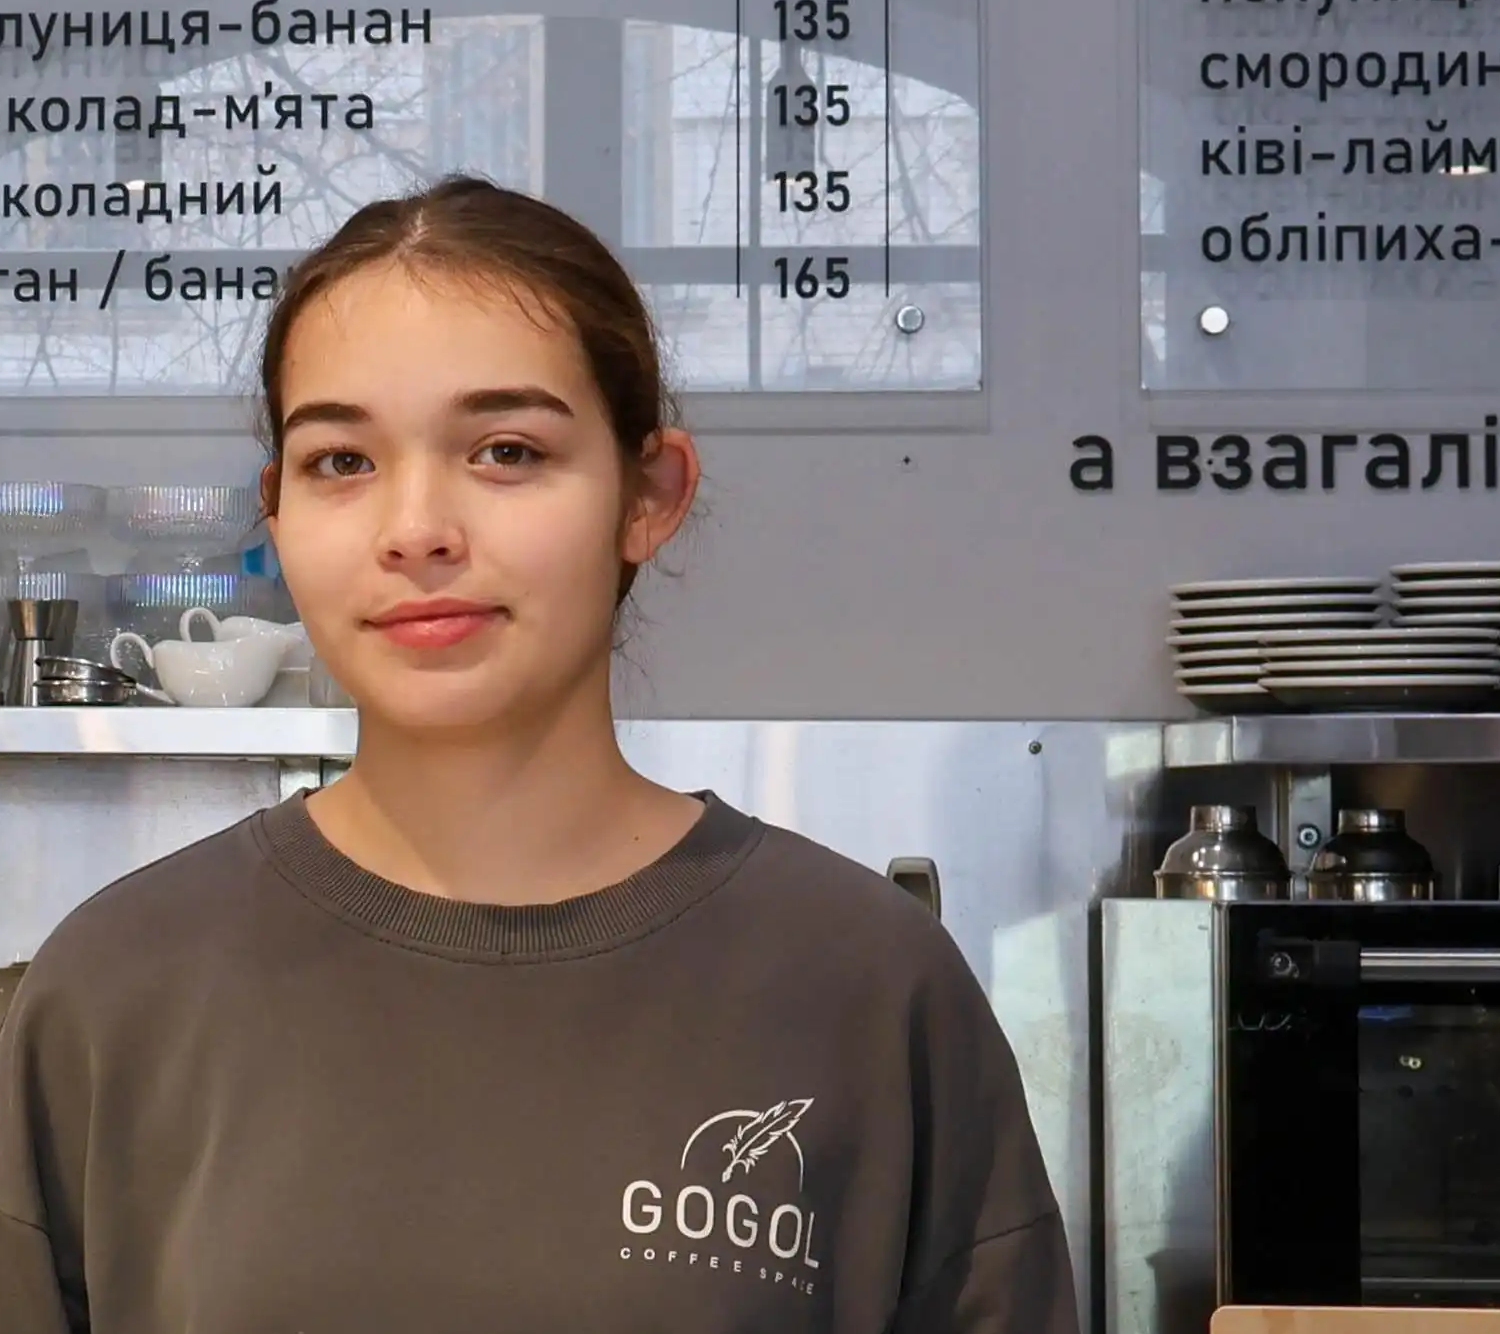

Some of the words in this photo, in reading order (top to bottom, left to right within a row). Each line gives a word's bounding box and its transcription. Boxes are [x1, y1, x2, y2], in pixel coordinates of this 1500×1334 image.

[773, 84, 850, 128] 135
[1200, 120, 1499, 177] ківі-лайм
[145, 254, 279, 301] бана
[774, 257, 850, 299] 165
[1071, 434, 1115, 490] а
[1155, 415, 1500, 490] взагалі
[622, 1180, 820, 1268] GOGOL
[620, 1247, 742, 1272] COFFEE
